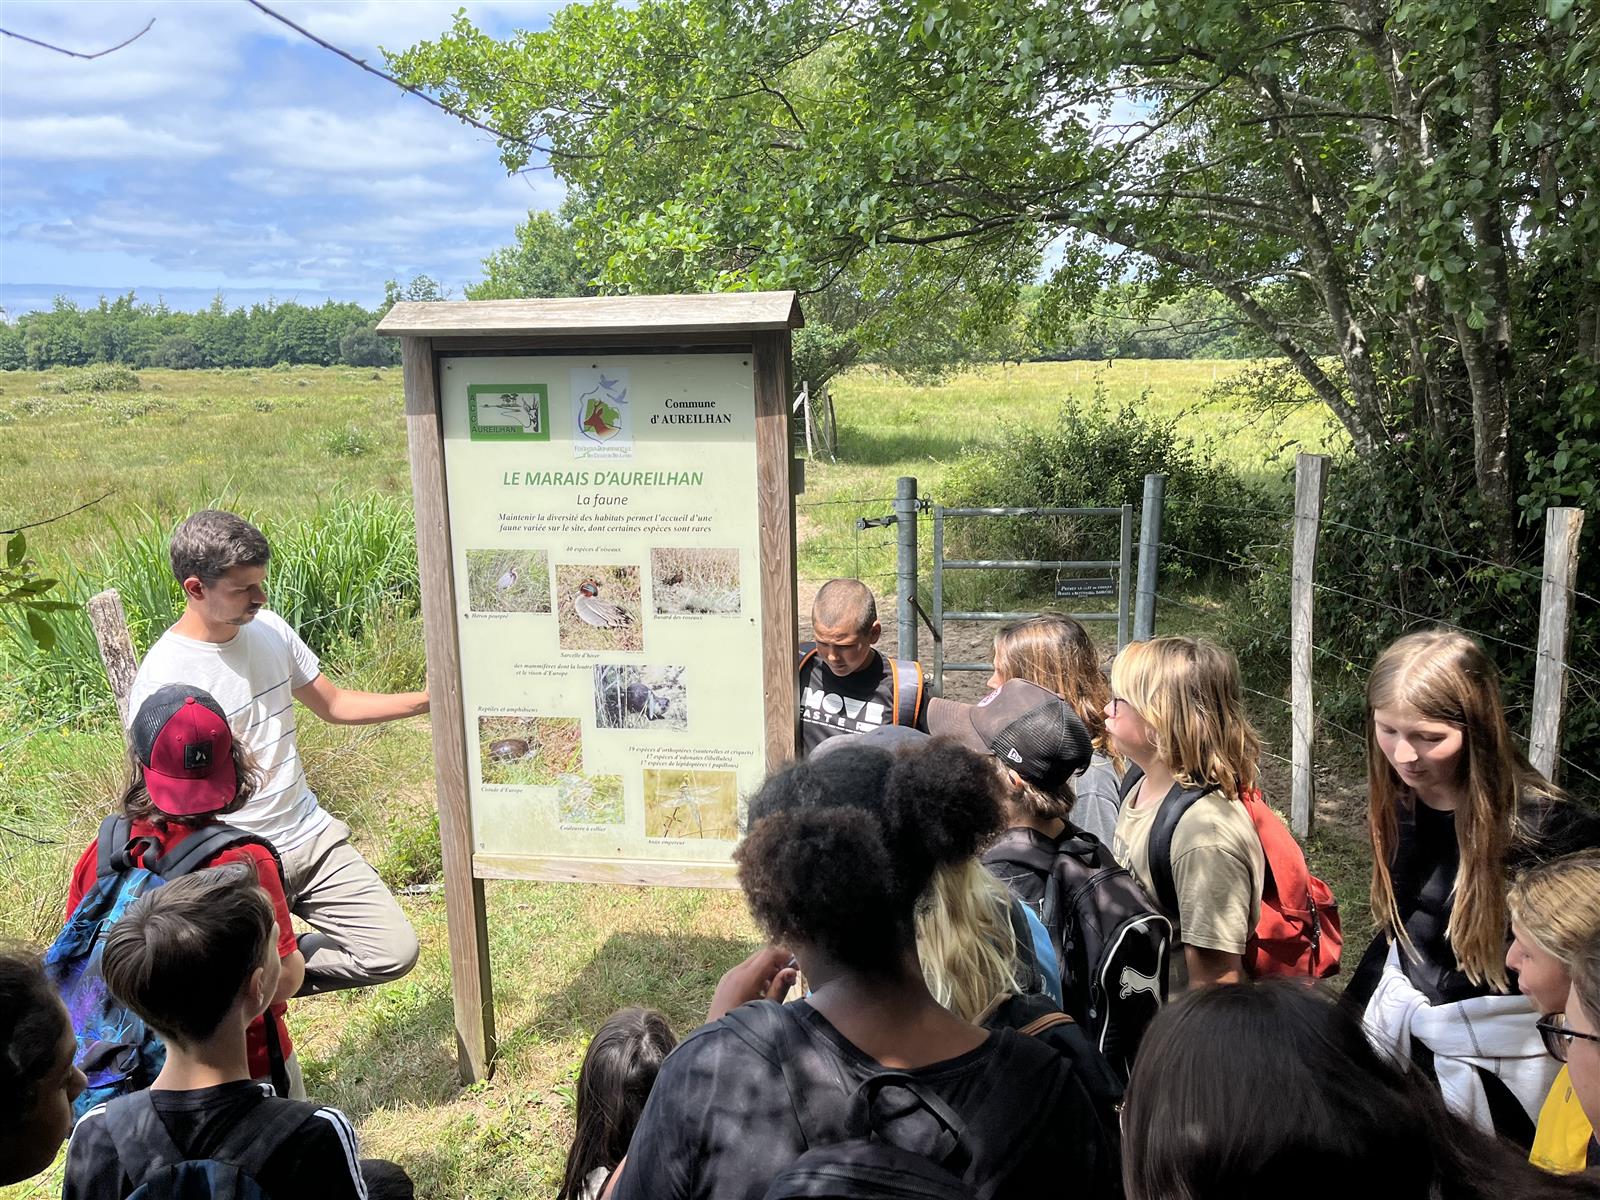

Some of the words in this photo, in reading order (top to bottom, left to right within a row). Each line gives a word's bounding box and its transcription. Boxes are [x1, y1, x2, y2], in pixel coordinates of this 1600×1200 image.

[665, 398, 716, 408] Commune
[503, 472, 520, 486] LE
[524, 472, 589, 486] MARAIS
[594, 472, 704, 486] D'AUREILHAN
[576, 494, 590, 505] La
[592, 494, 628, 508] faune
[626, 515, 653, 523] permet
[500, 524, 521, 532] faune
[643, 525, 671, 534] espèces
[800, 687, 884, 724] MOVE
